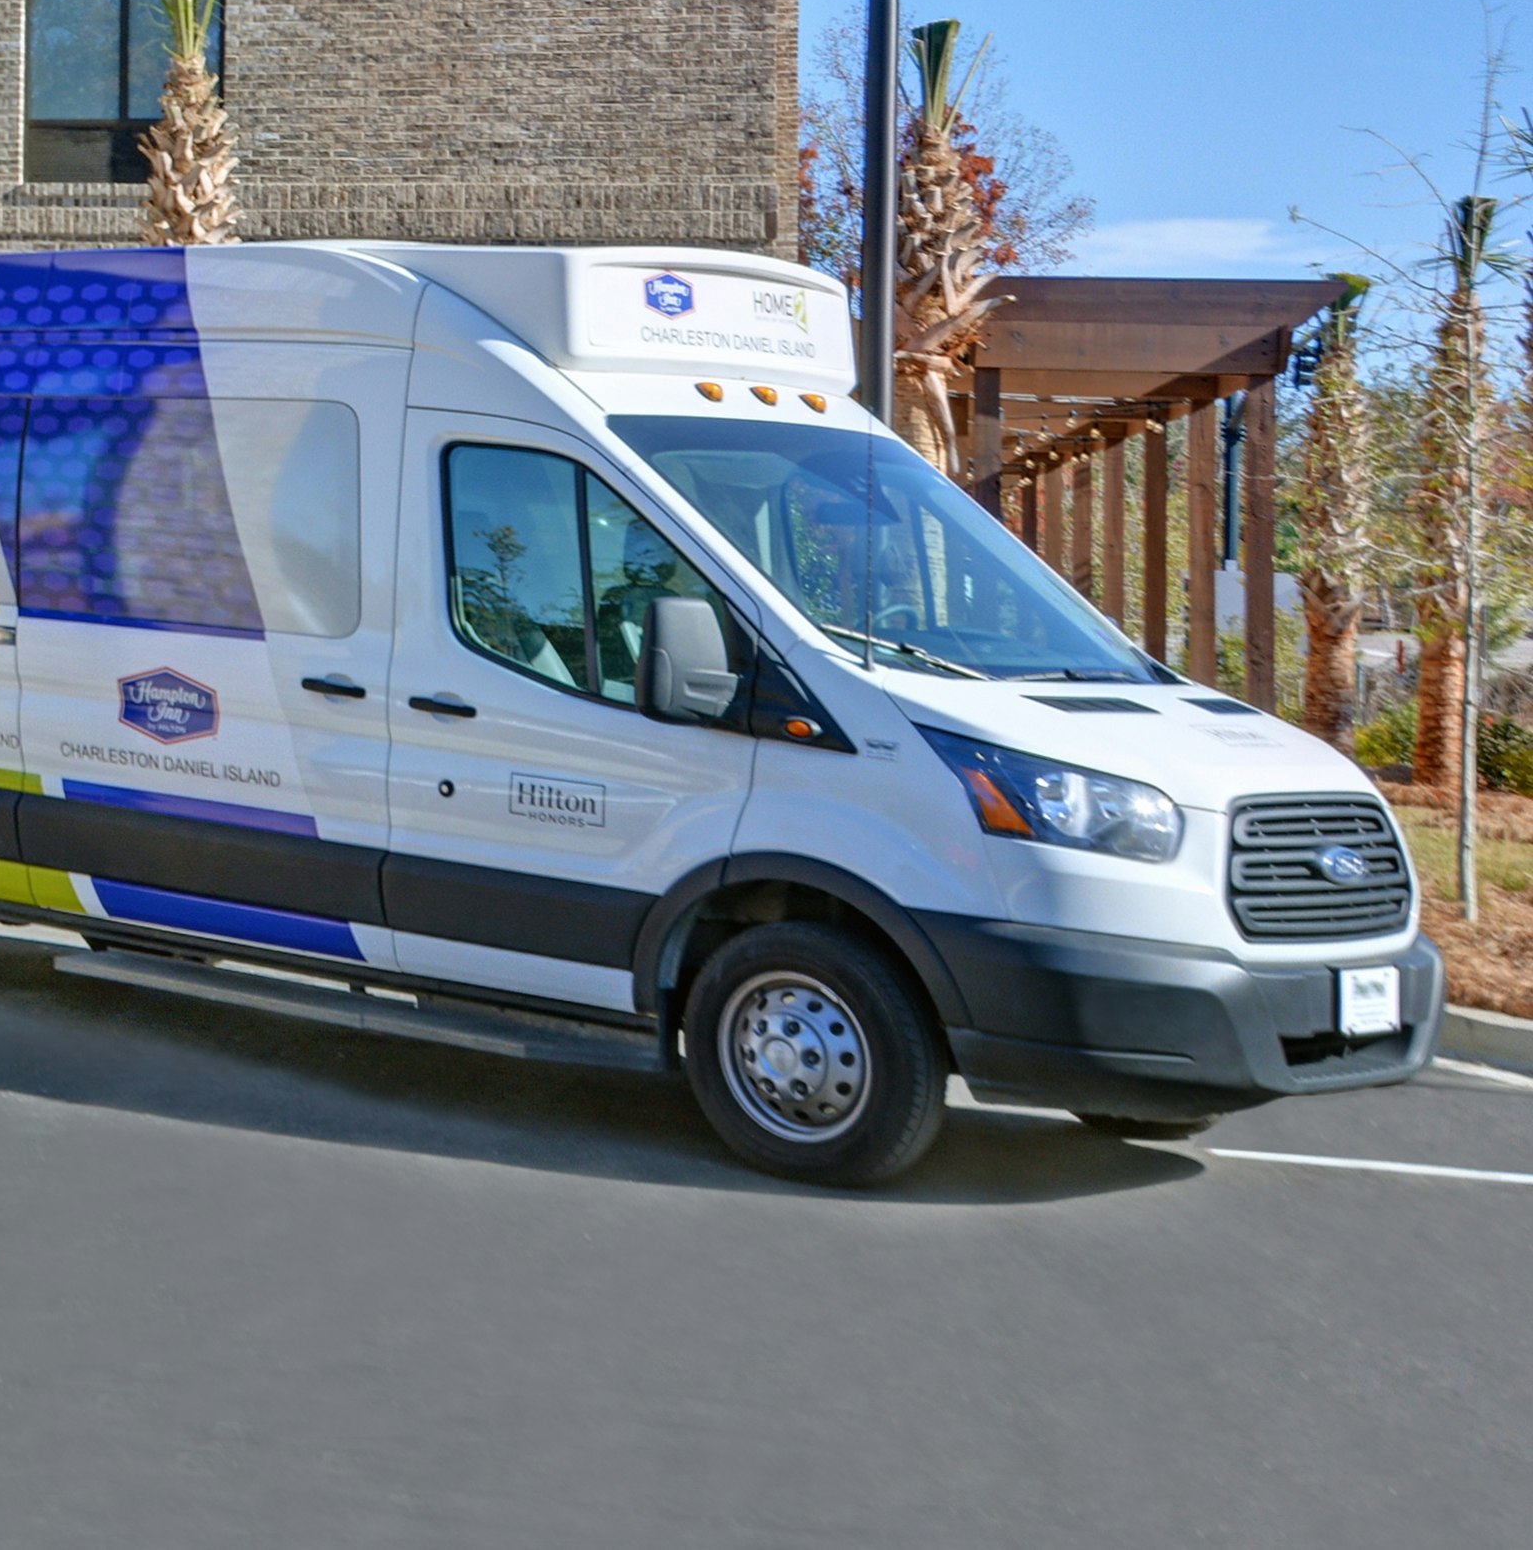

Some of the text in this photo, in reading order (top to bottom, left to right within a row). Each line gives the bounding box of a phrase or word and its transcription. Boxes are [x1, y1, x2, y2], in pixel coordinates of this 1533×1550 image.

[752, 291, 793, 317] HOME
[640, 325, 815, 359] CHARLESTON DANIEL ISLAND
[128, 680, 206, 710] Hampton
[146, 701, 191, 725] Inn
[59, 741, 281, 788] CHARLESTON DANIEL ISLAND
[517, 781, 597, 816] Hilton
[527, 811, 586, 829] HONORS
